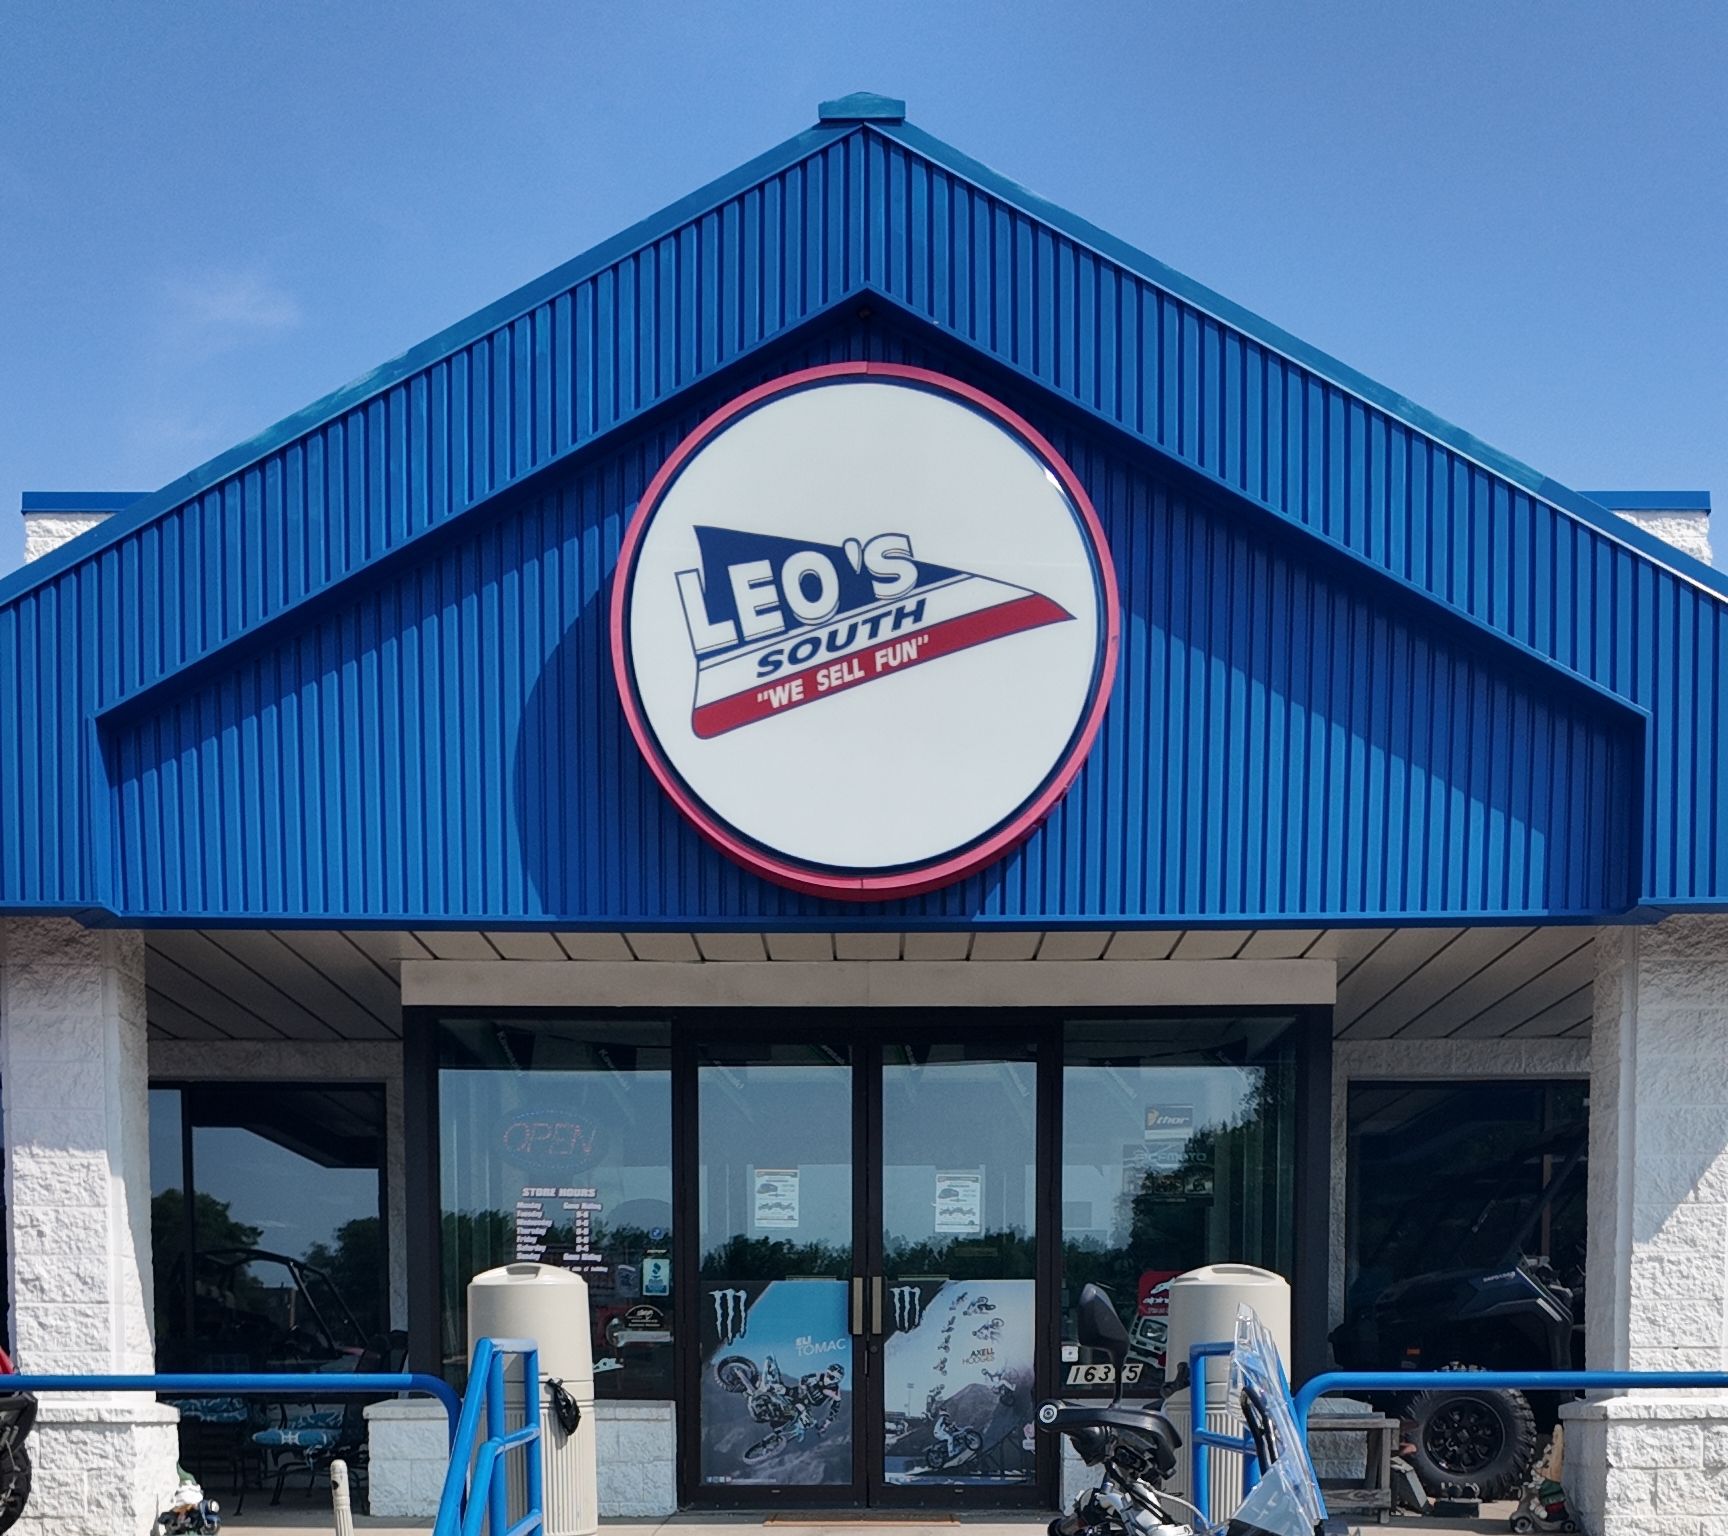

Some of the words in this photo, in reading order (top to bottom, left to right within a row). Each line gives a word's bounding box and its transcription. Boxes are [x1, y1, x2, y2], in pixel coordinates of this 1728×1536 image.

[675, 533, 918, 660] LEO'S
[756, 598, 927, 678] SOUTH
[817, 658, 865, 692] SELL
[1156, 1115, 1190, 1125] thor
[503, 1122, 597, 1155] OPEN
[522, 1187, 557, 1197] STORE
[558, 1188, 597, 1198] HOURS
[795, 1338, 847, 1357] TOMAC
[970, 1347, 995, 1358] AXELL
[1072, 1365, 1140, 1383] 1635
